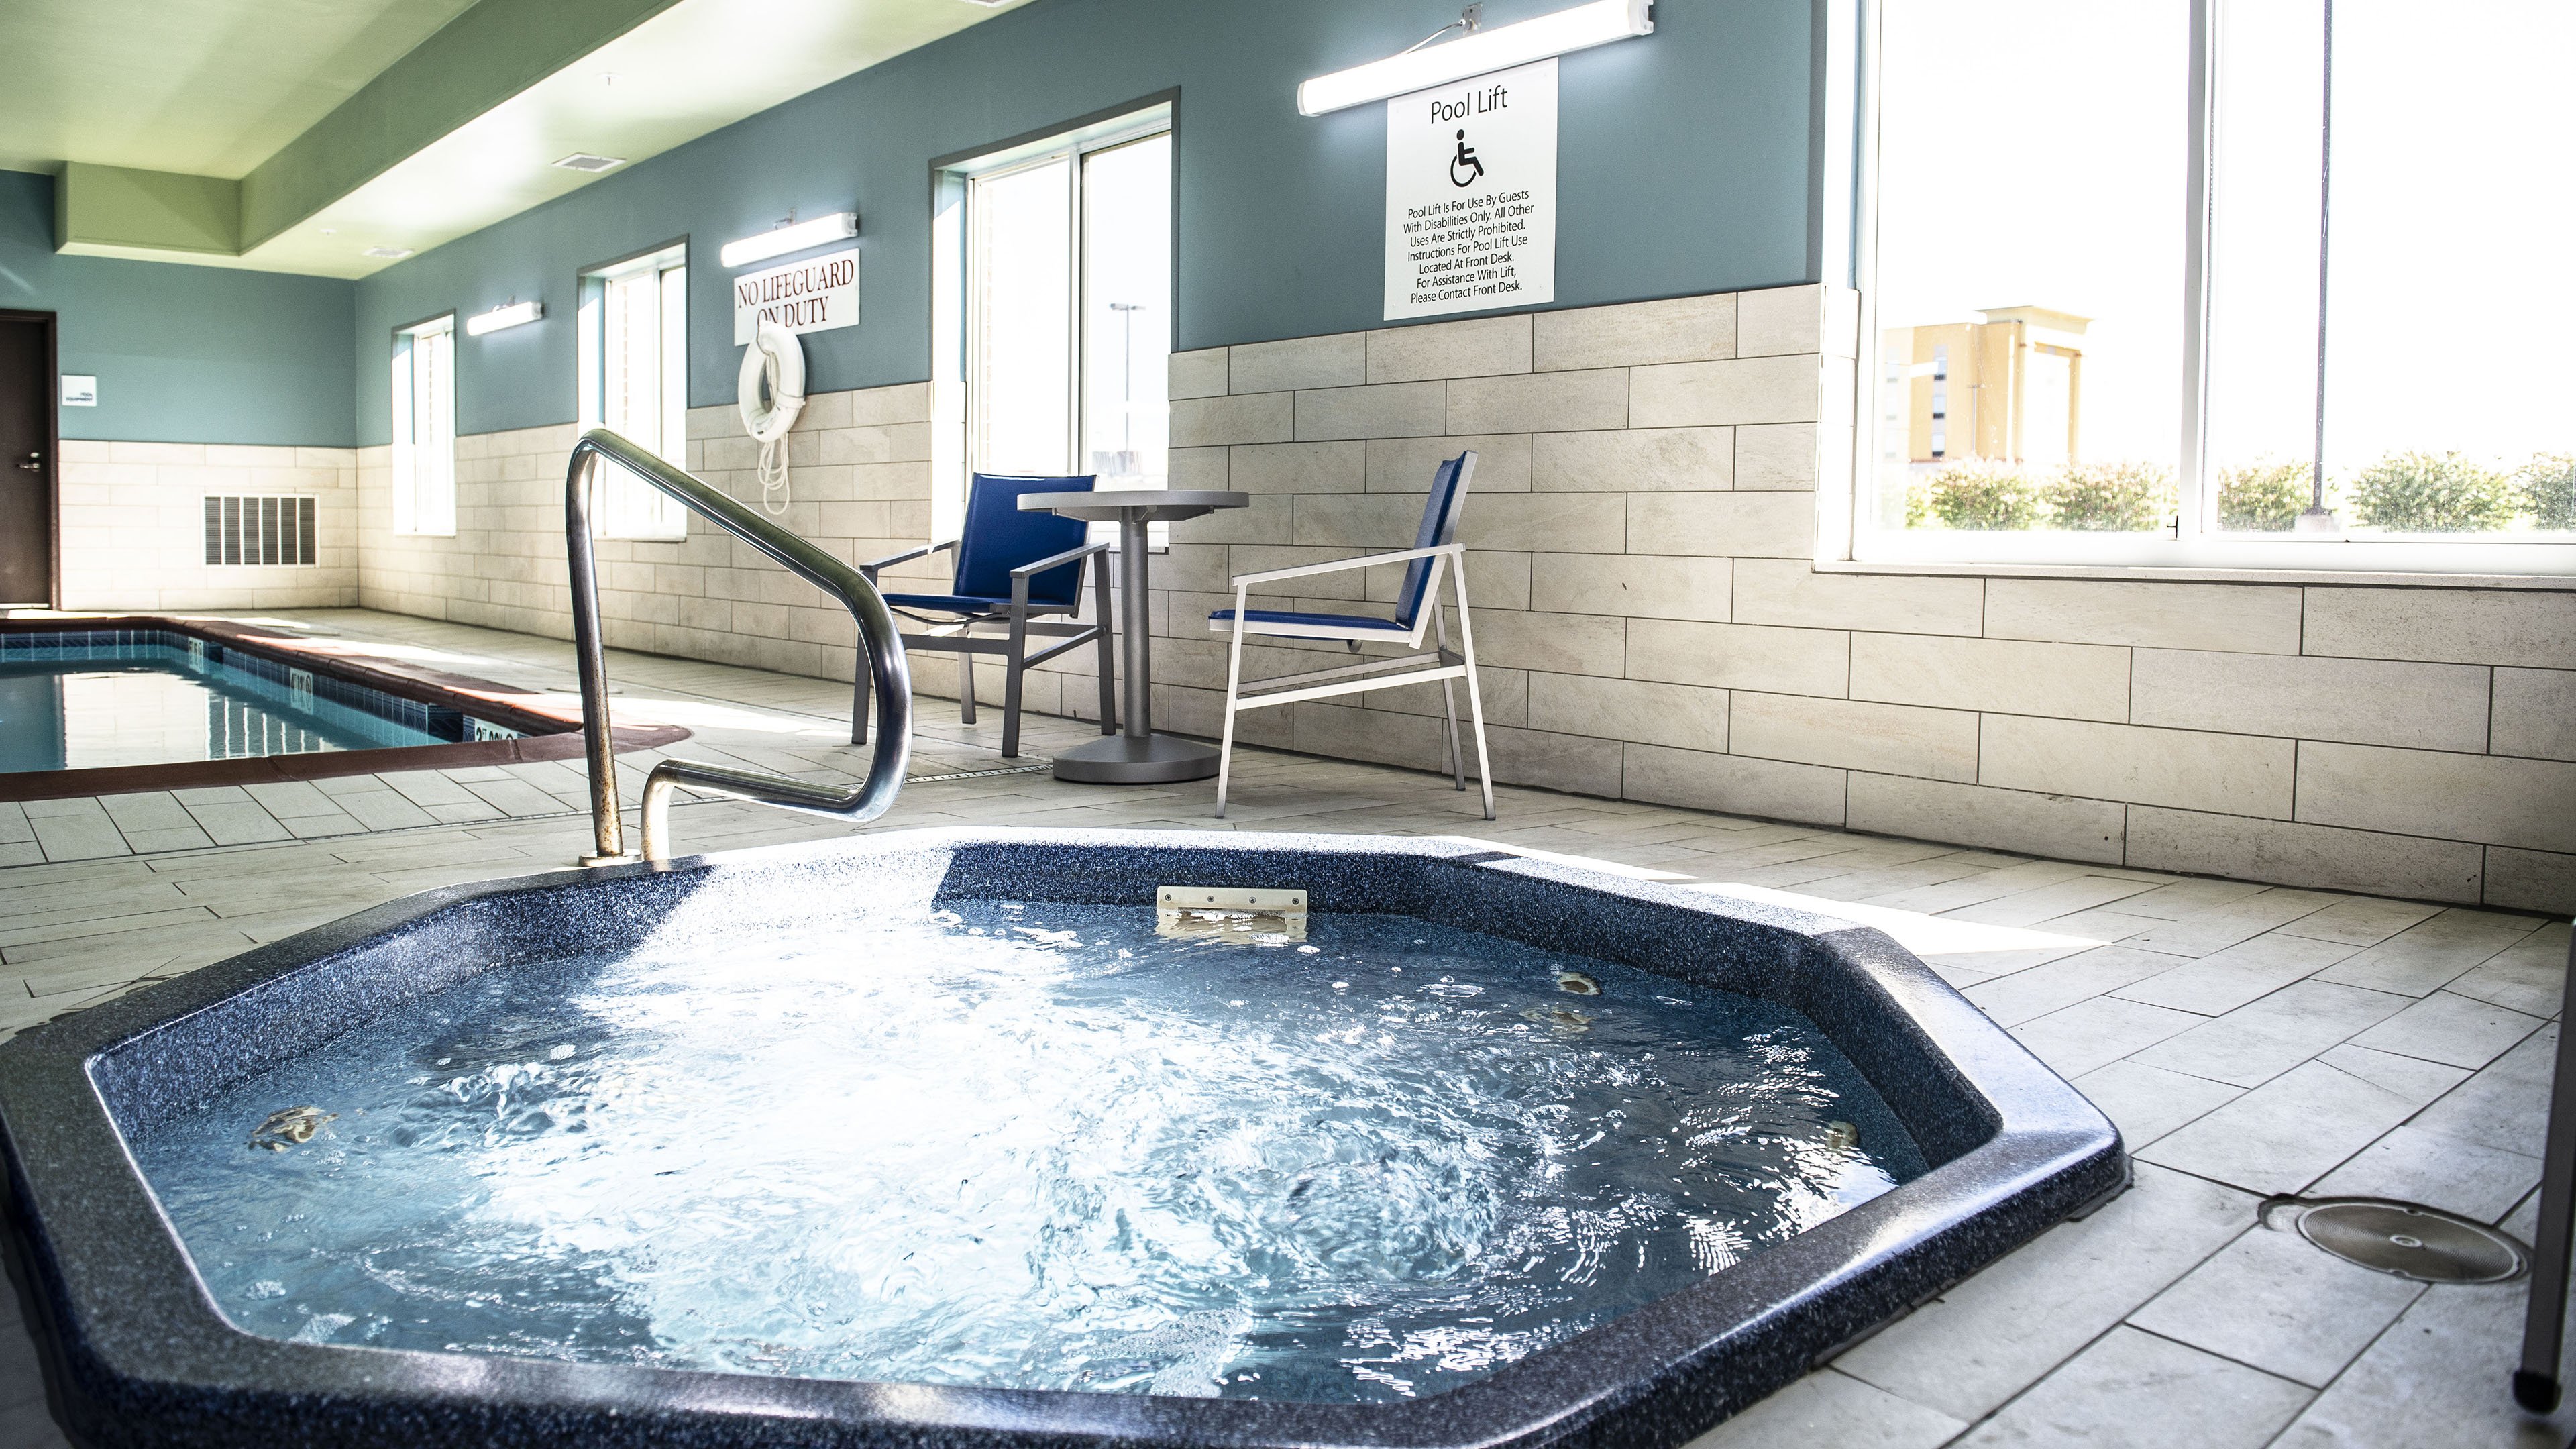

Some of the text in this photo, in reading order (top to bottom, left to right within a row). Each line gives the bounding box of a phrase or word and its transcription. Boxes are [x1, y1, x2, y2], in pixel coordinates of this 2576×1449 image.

[1431, 85, 1508, 124] Pool Lift
[1408, 190, 1529, 219] Pool Lift Is For Use By Guests
[1403, 204, 1534, 234] With Disabilities Only. All Other
[1410, 219, 1525, 247] Uses Are Strictly Prohibited.
[1408, 235, 1528, 262] Instructions For Pool Lift Use
[1419, 251, 1514, 274] Located At Front Desk.
[738, 259, 854, 309] NO LIFEGUARD
[1417, 265, 1517, 288] For Assistance With Lift,
[1411, 280, 1523, 304] Please Contact Front Desk.
[784, 296, 829, 328] DUTY
